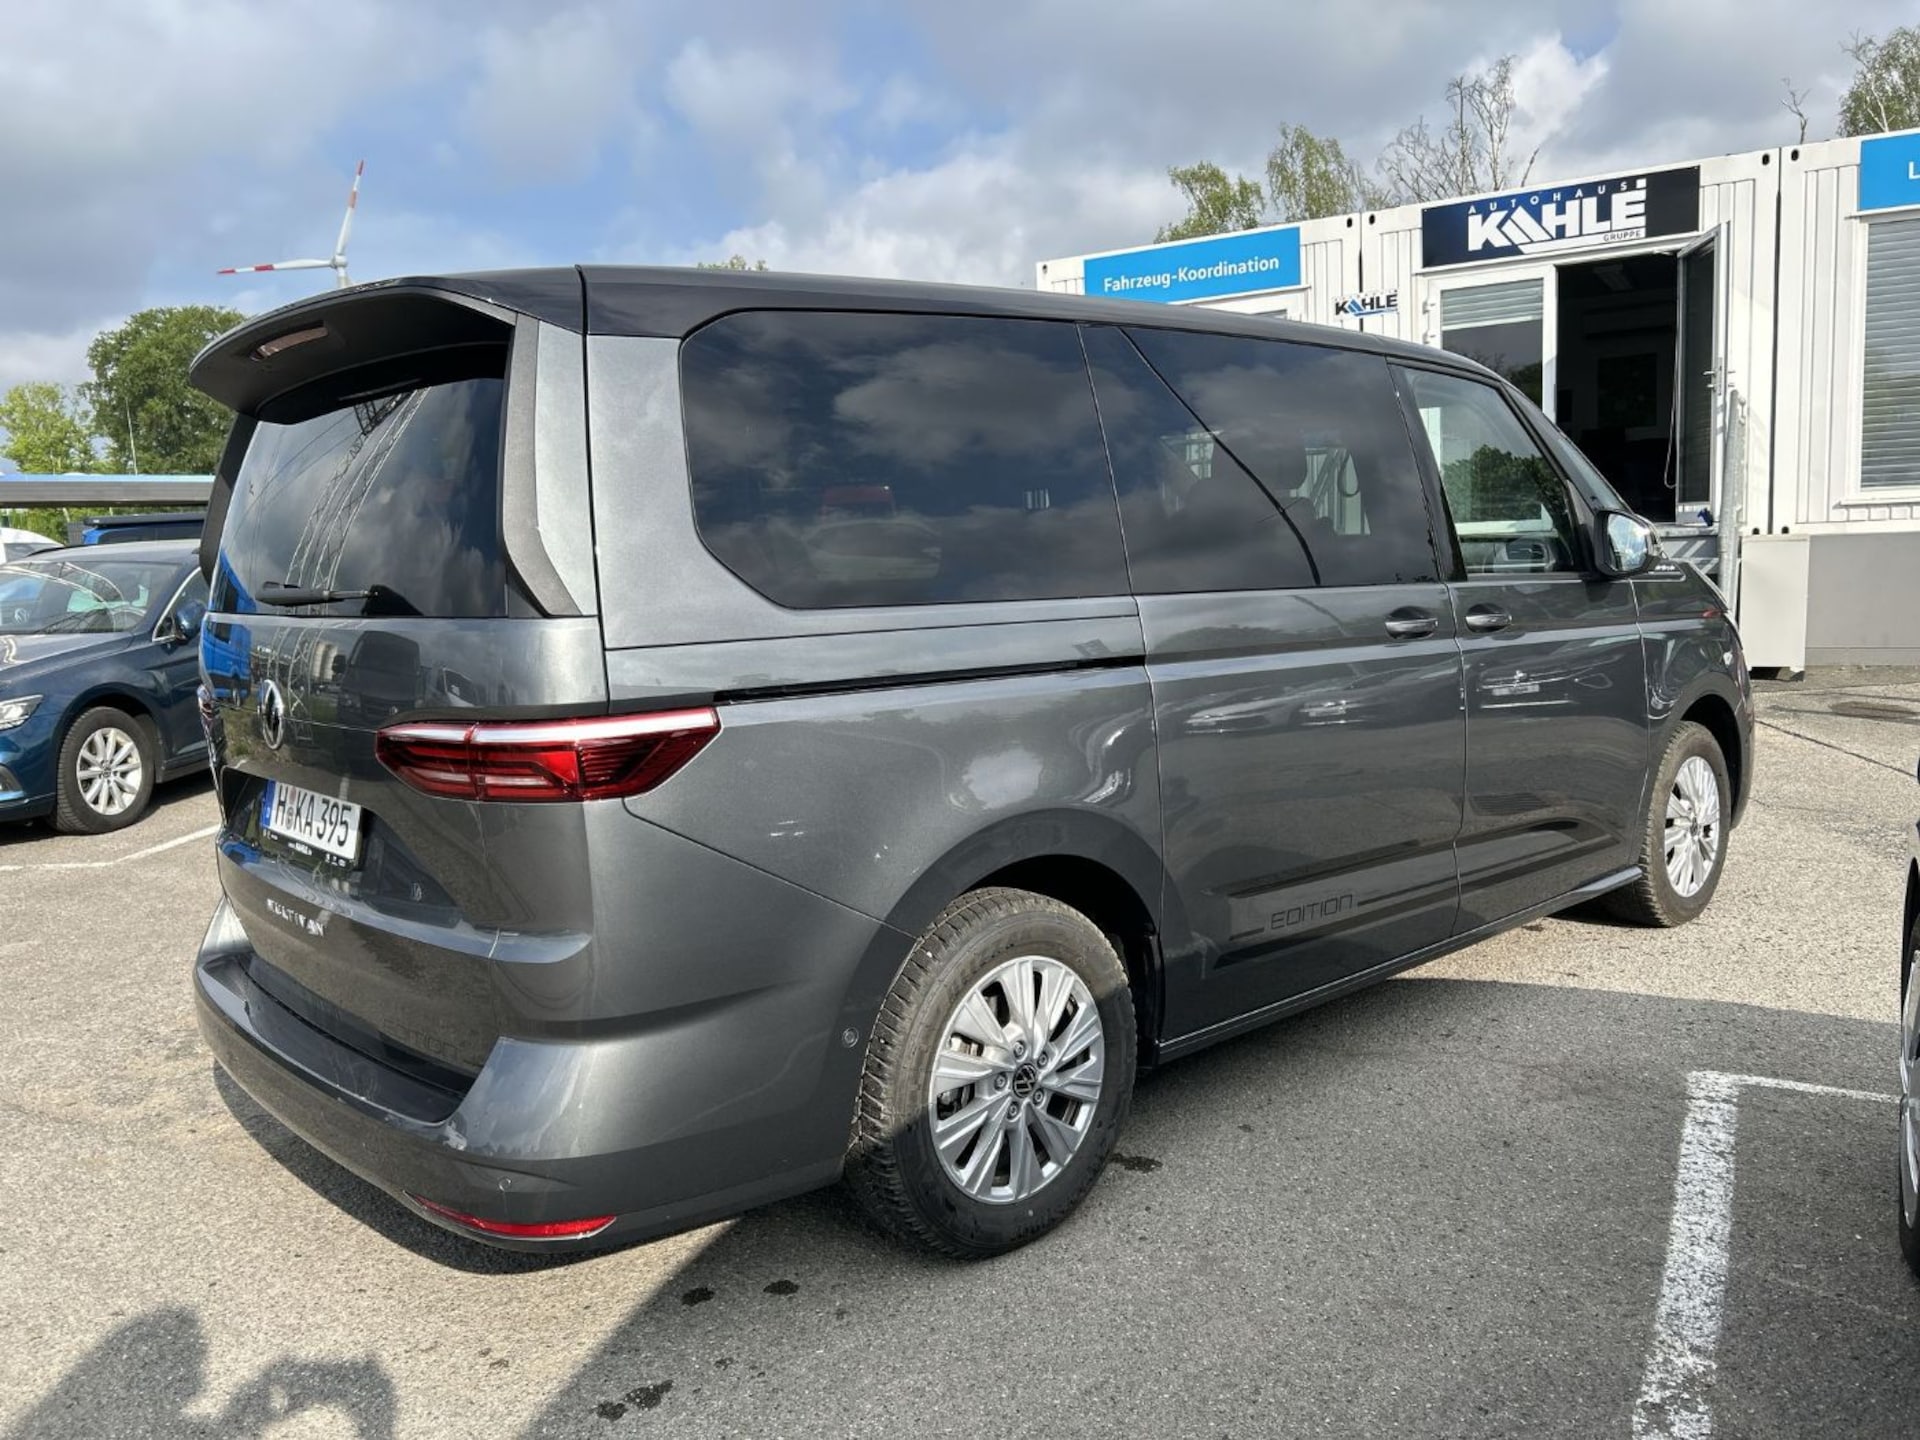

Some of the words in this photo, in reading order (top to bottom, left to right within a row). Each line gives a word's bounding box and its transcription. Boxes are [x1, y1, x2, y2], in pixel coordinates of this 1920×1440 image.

[1468, 180, 1628, 215] AUTOHAUS
[1468, 188, 1647, 252] KAHLE
[1603, 229, 1641, 243] GRUPPE
[1103, 254, 1280, 293] Fahrzeug-Koordination
[1335, 293, 1398, 316] KAHLE
[1271, 893, 1353, 931] EDITION
